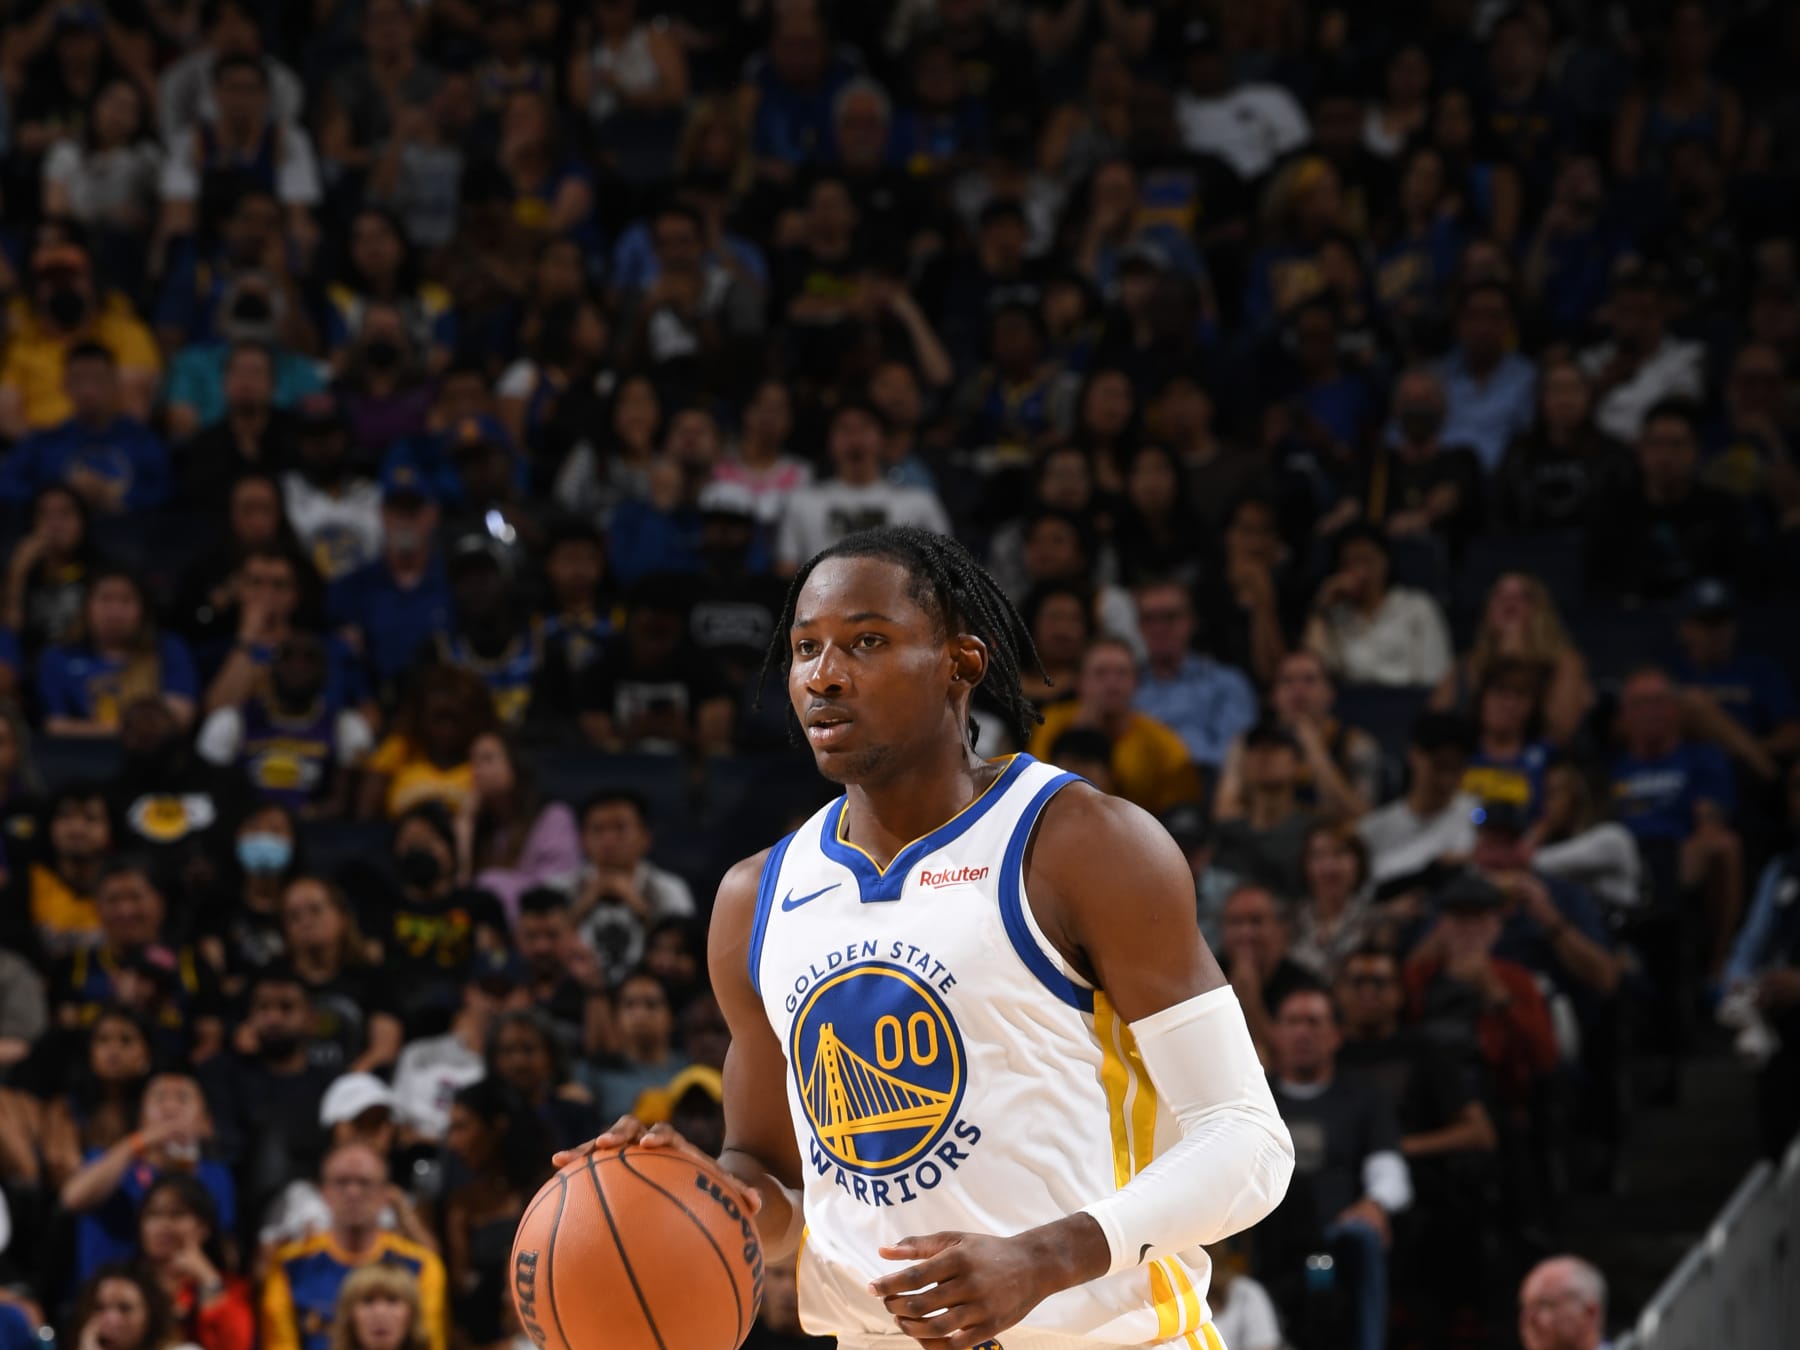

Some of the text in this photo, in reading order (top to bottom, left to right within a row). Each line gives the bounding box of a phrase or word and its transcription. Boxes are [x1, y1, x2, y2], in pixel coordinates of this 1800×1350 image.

[919, 866, 989, 888] Rakuten
[785, 939, 957, 1013] GOLDEN STATE
[874, 1011, 938, 1070] 00
[809, 1119, 982, 1207] WARRIORS
